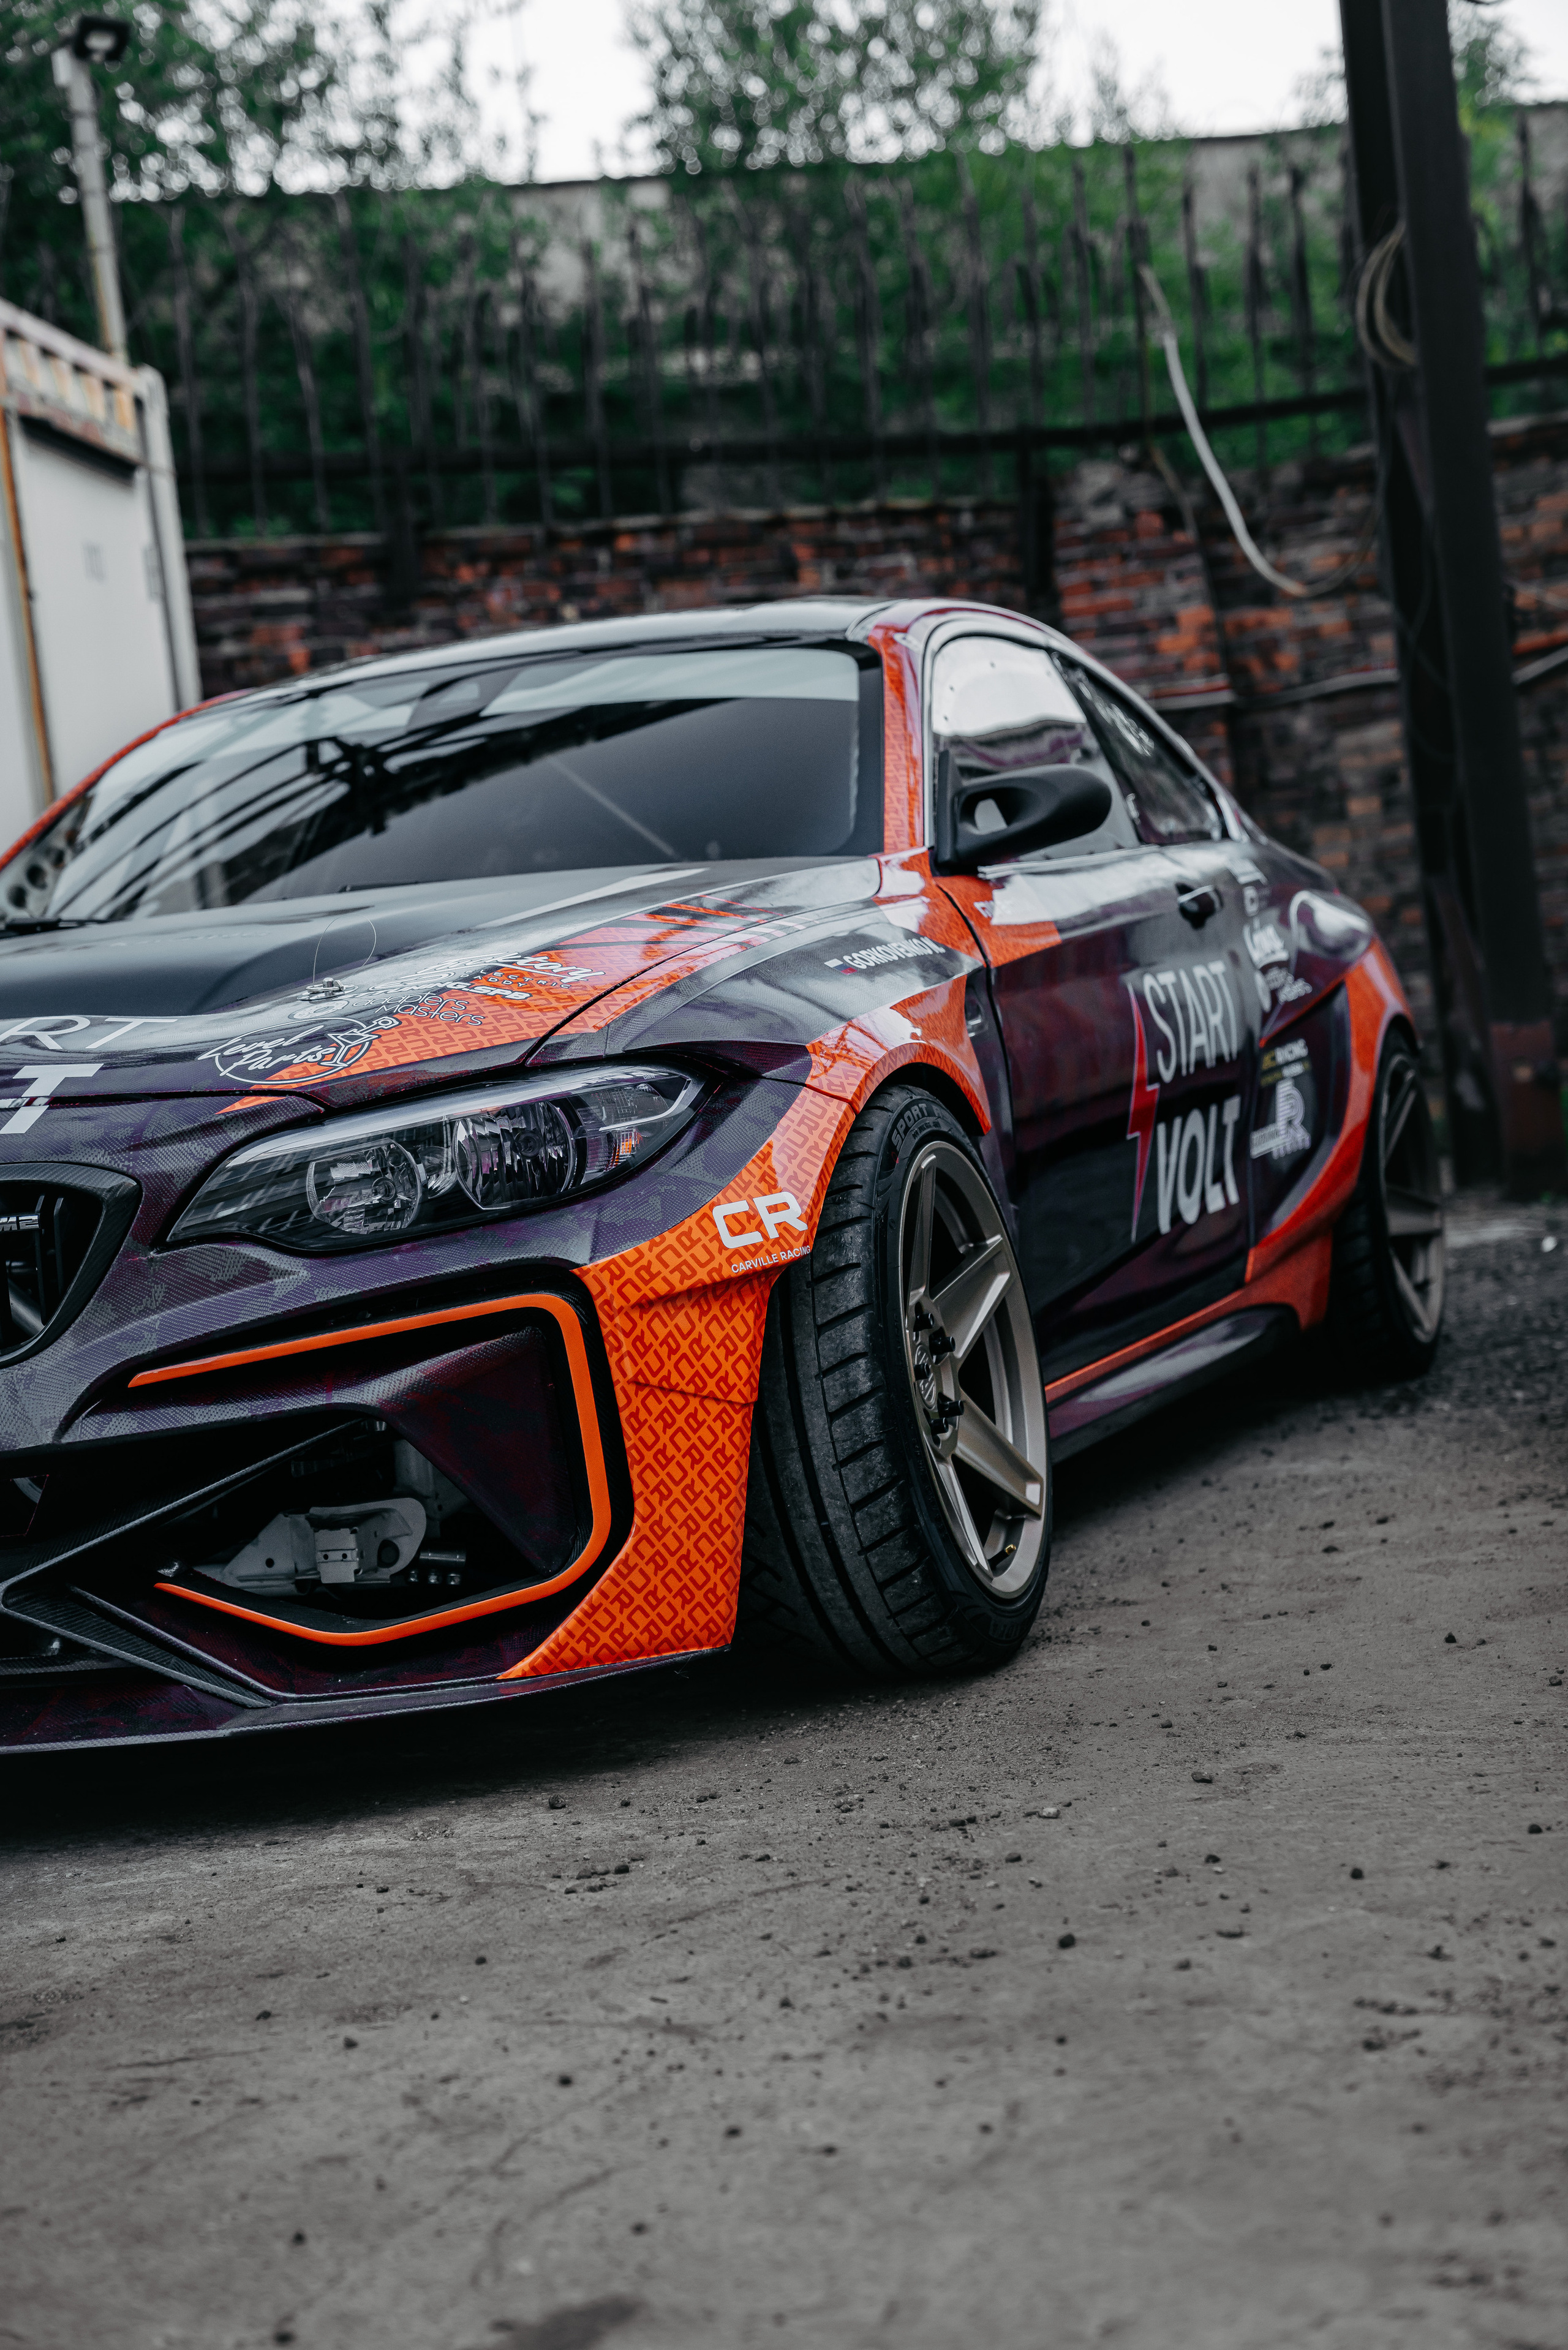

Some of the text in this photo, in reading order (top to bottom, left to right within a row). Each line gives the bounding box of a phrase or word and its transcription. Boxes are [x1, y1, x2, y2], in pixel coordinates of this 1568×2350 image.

[353, 992, 469, 1011] adapters
[374, 1001, 485, 1026] Masters
[1143, 960, 1237, 1083] START
[197, 1025, 325, 1060] Level
[219, 1045, 337, 1077] Parts
[891, 1103, 929, 1151] SPORT
[1156, 1094, 1241, 1235] VOLT
[0, 1215, 40, 1232] M2
[712, 1191, 809, 1249] CR
[731, 1245, 811, 1273] CARVILLE RACING
